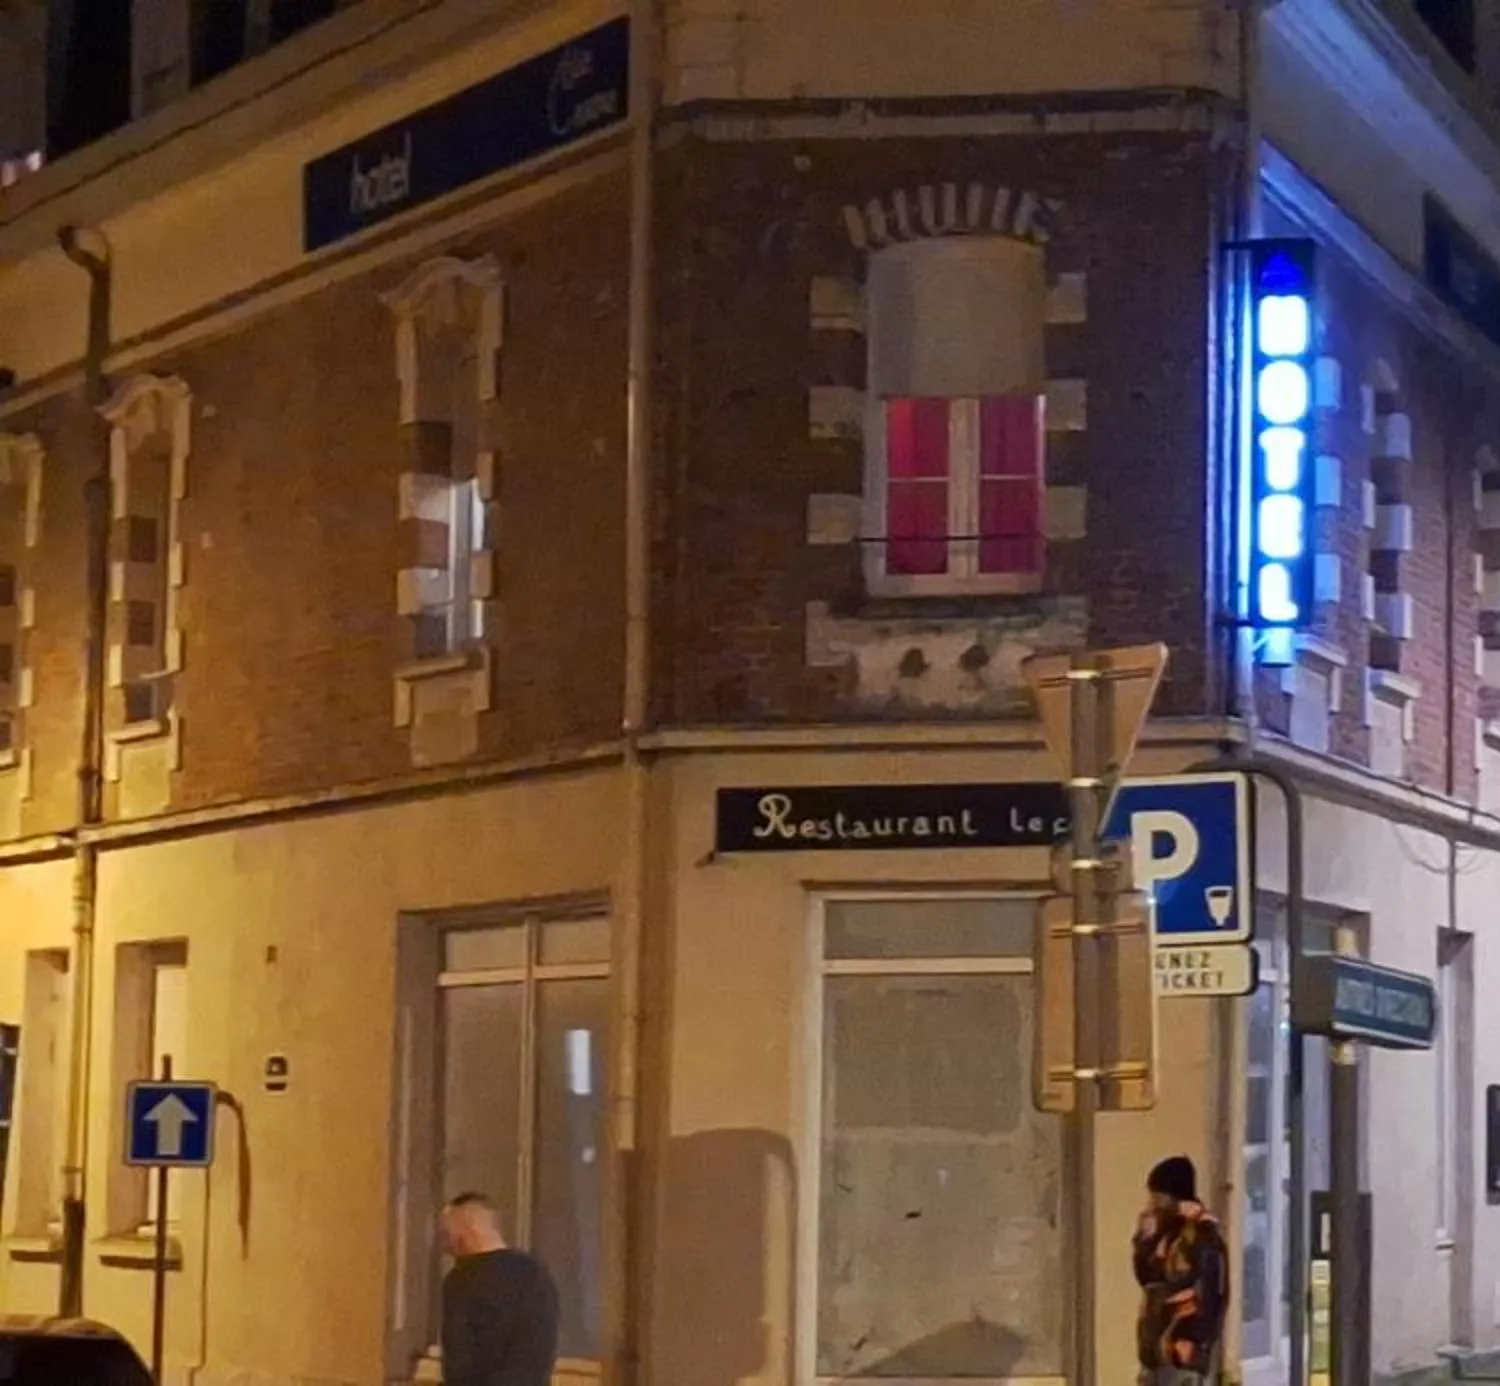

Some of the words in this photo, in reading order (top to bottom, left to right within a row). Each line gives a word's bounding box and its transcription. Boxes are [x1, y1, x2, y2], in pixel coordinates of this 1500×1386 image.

[349, 129, 413, 214] hotel
[1257, 295, 1309, 622] HOTEL
[752, 793, 979, 840] Restaurant
[1131, 810, 1200, 893] P
